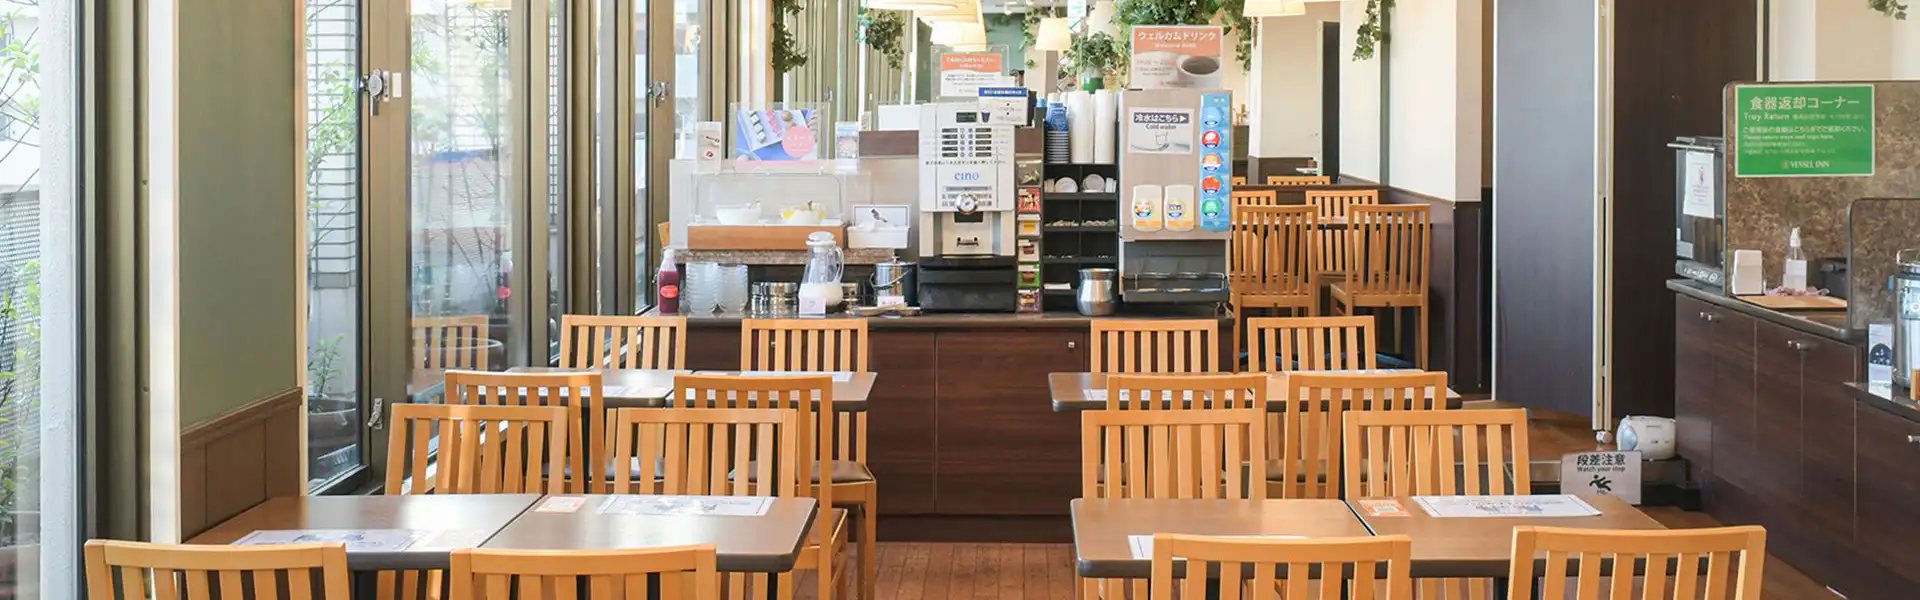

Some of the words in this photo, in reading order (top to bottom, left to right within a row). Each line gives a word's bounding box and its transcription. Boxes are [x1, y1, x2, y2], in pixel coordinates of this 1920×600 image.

[1750, 95, 1860, 110] 食器返却コーナー
[1135, 113, 1179, 123] 冷水はこちら
[1764, 112, 1790, 120] Return
[1577, 453, 1626, 466] 段差注意
